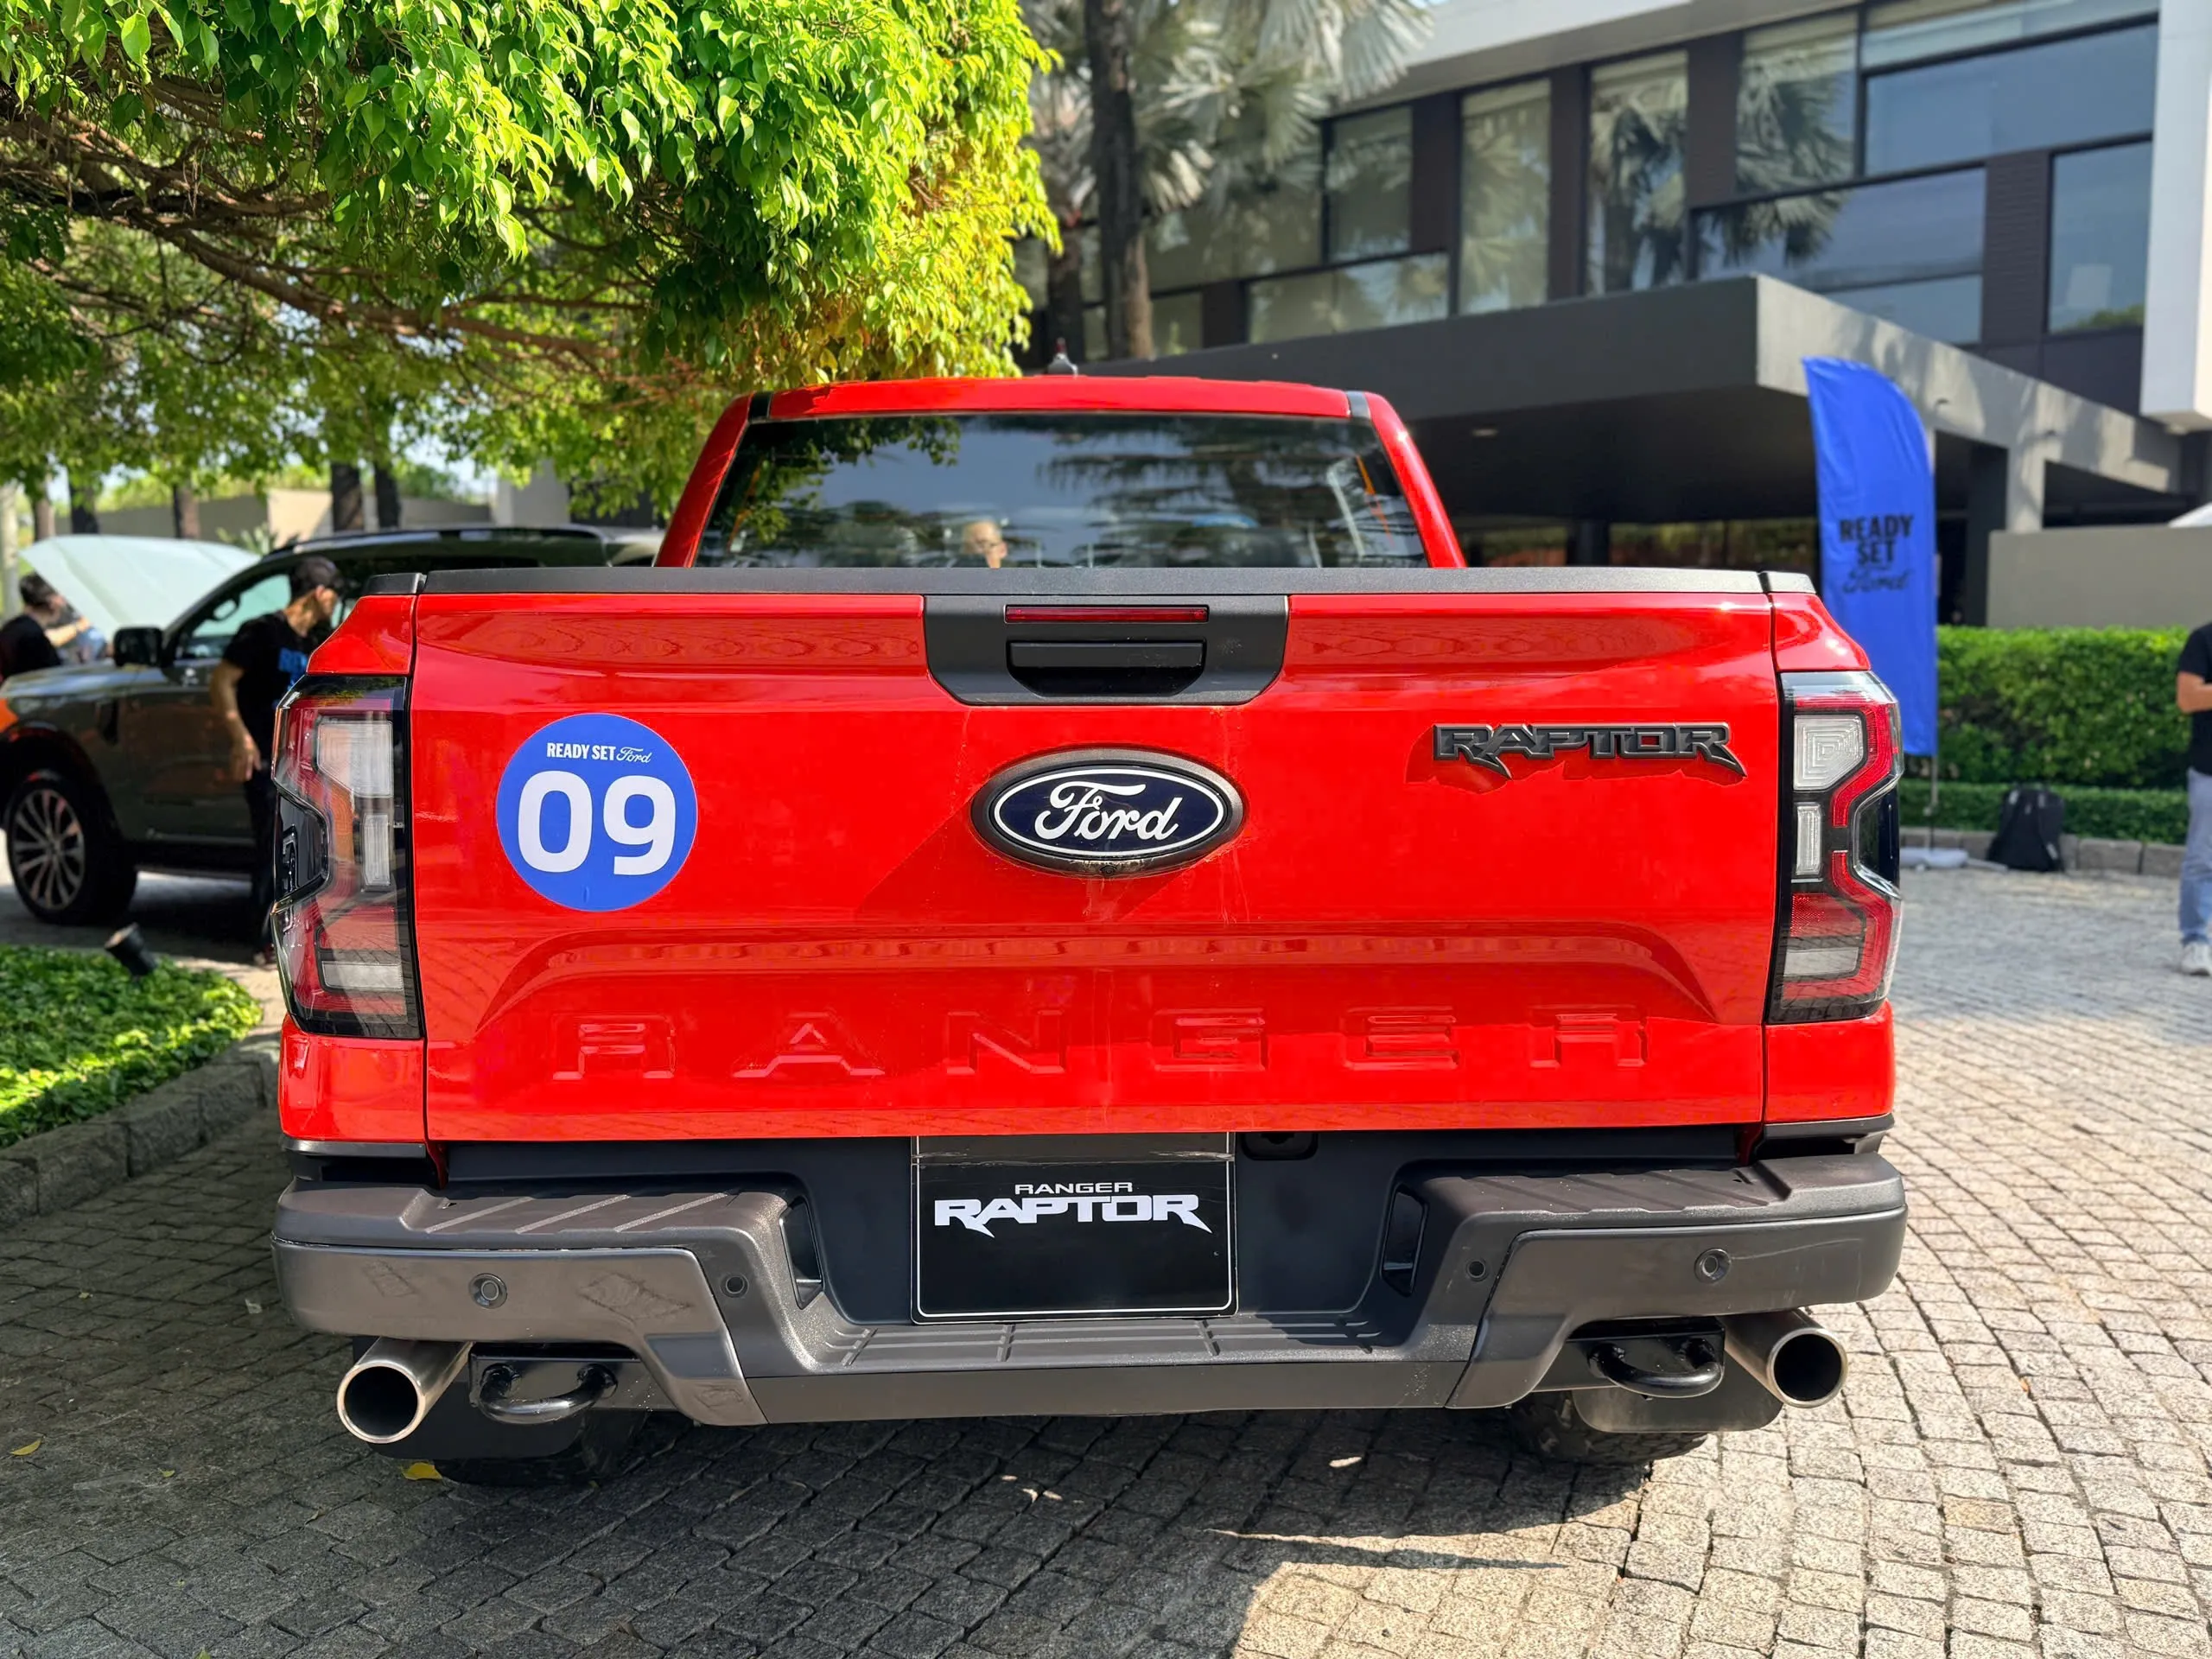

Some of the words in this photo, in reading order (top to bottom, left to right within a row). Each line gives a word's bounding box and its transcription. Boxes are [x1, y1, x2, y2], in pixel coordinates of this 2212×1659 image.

[1840, 514, 1914, 543] READY
[1857, 539, 1894, 564] SET
[546, 742, 589, 760] READY
[591, 744, 616, 761] SET
[616, 746, 652, 763] Ford
[1433, 721, 1747, 778] RAPTOR
[518, 770, 677, 876] 09
[1034, 780, 1184, 840] Ford
[551, 1005, 1648, 1080] RANGER
[1014, 1181, 1133, 1194] RANGER
[934, 1193, 1213, 1238] RAPTOR
